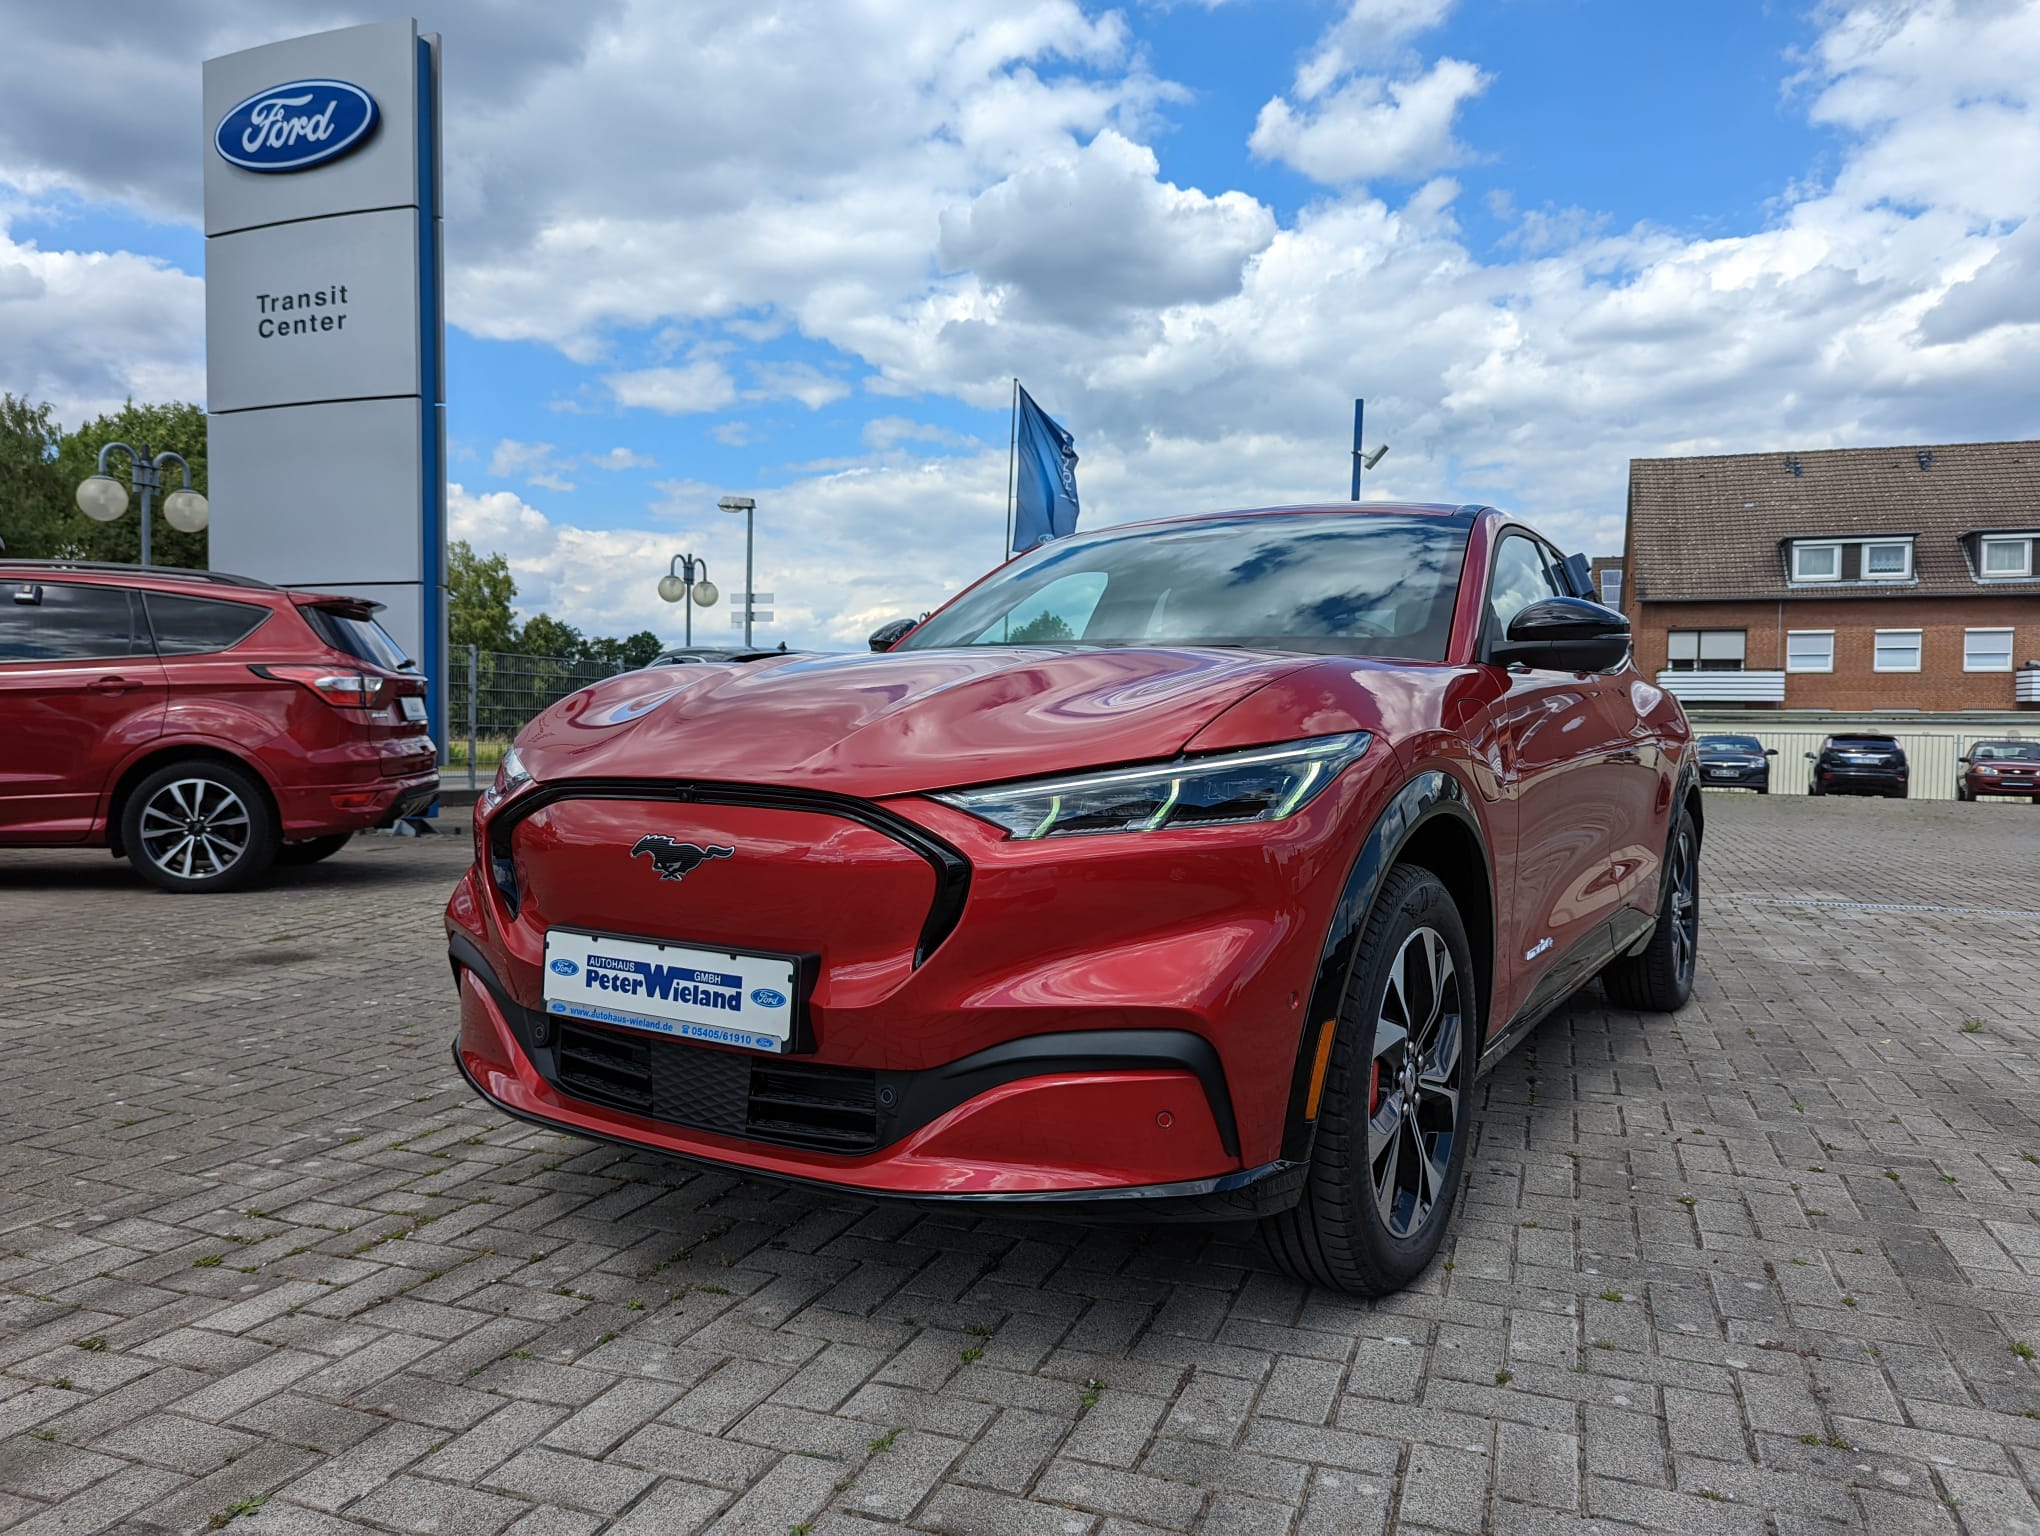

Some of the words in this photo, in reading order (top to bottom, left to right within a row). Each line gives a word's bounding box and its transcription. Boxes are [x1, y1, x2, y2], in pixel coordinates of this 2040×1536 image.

[242, 94, 337, 153] Ford
[257, 285, 348, 313] Transit
[258, 314, 347, 339] Center
[555, 961, 574, 974] Ford
[588, 956, 635, 972] AUTOHAUS
[694, 971, 721, 985] GMBH
[585, 968, 643, 995] Peter
[644, 963, 743, 1012] Wieland
[757, 990, 779, 1004] Ford
[570, 1007, 673, 1032] www.autohaus-wieland.de
[691, 1026, 752, 1045] 05405/61910
